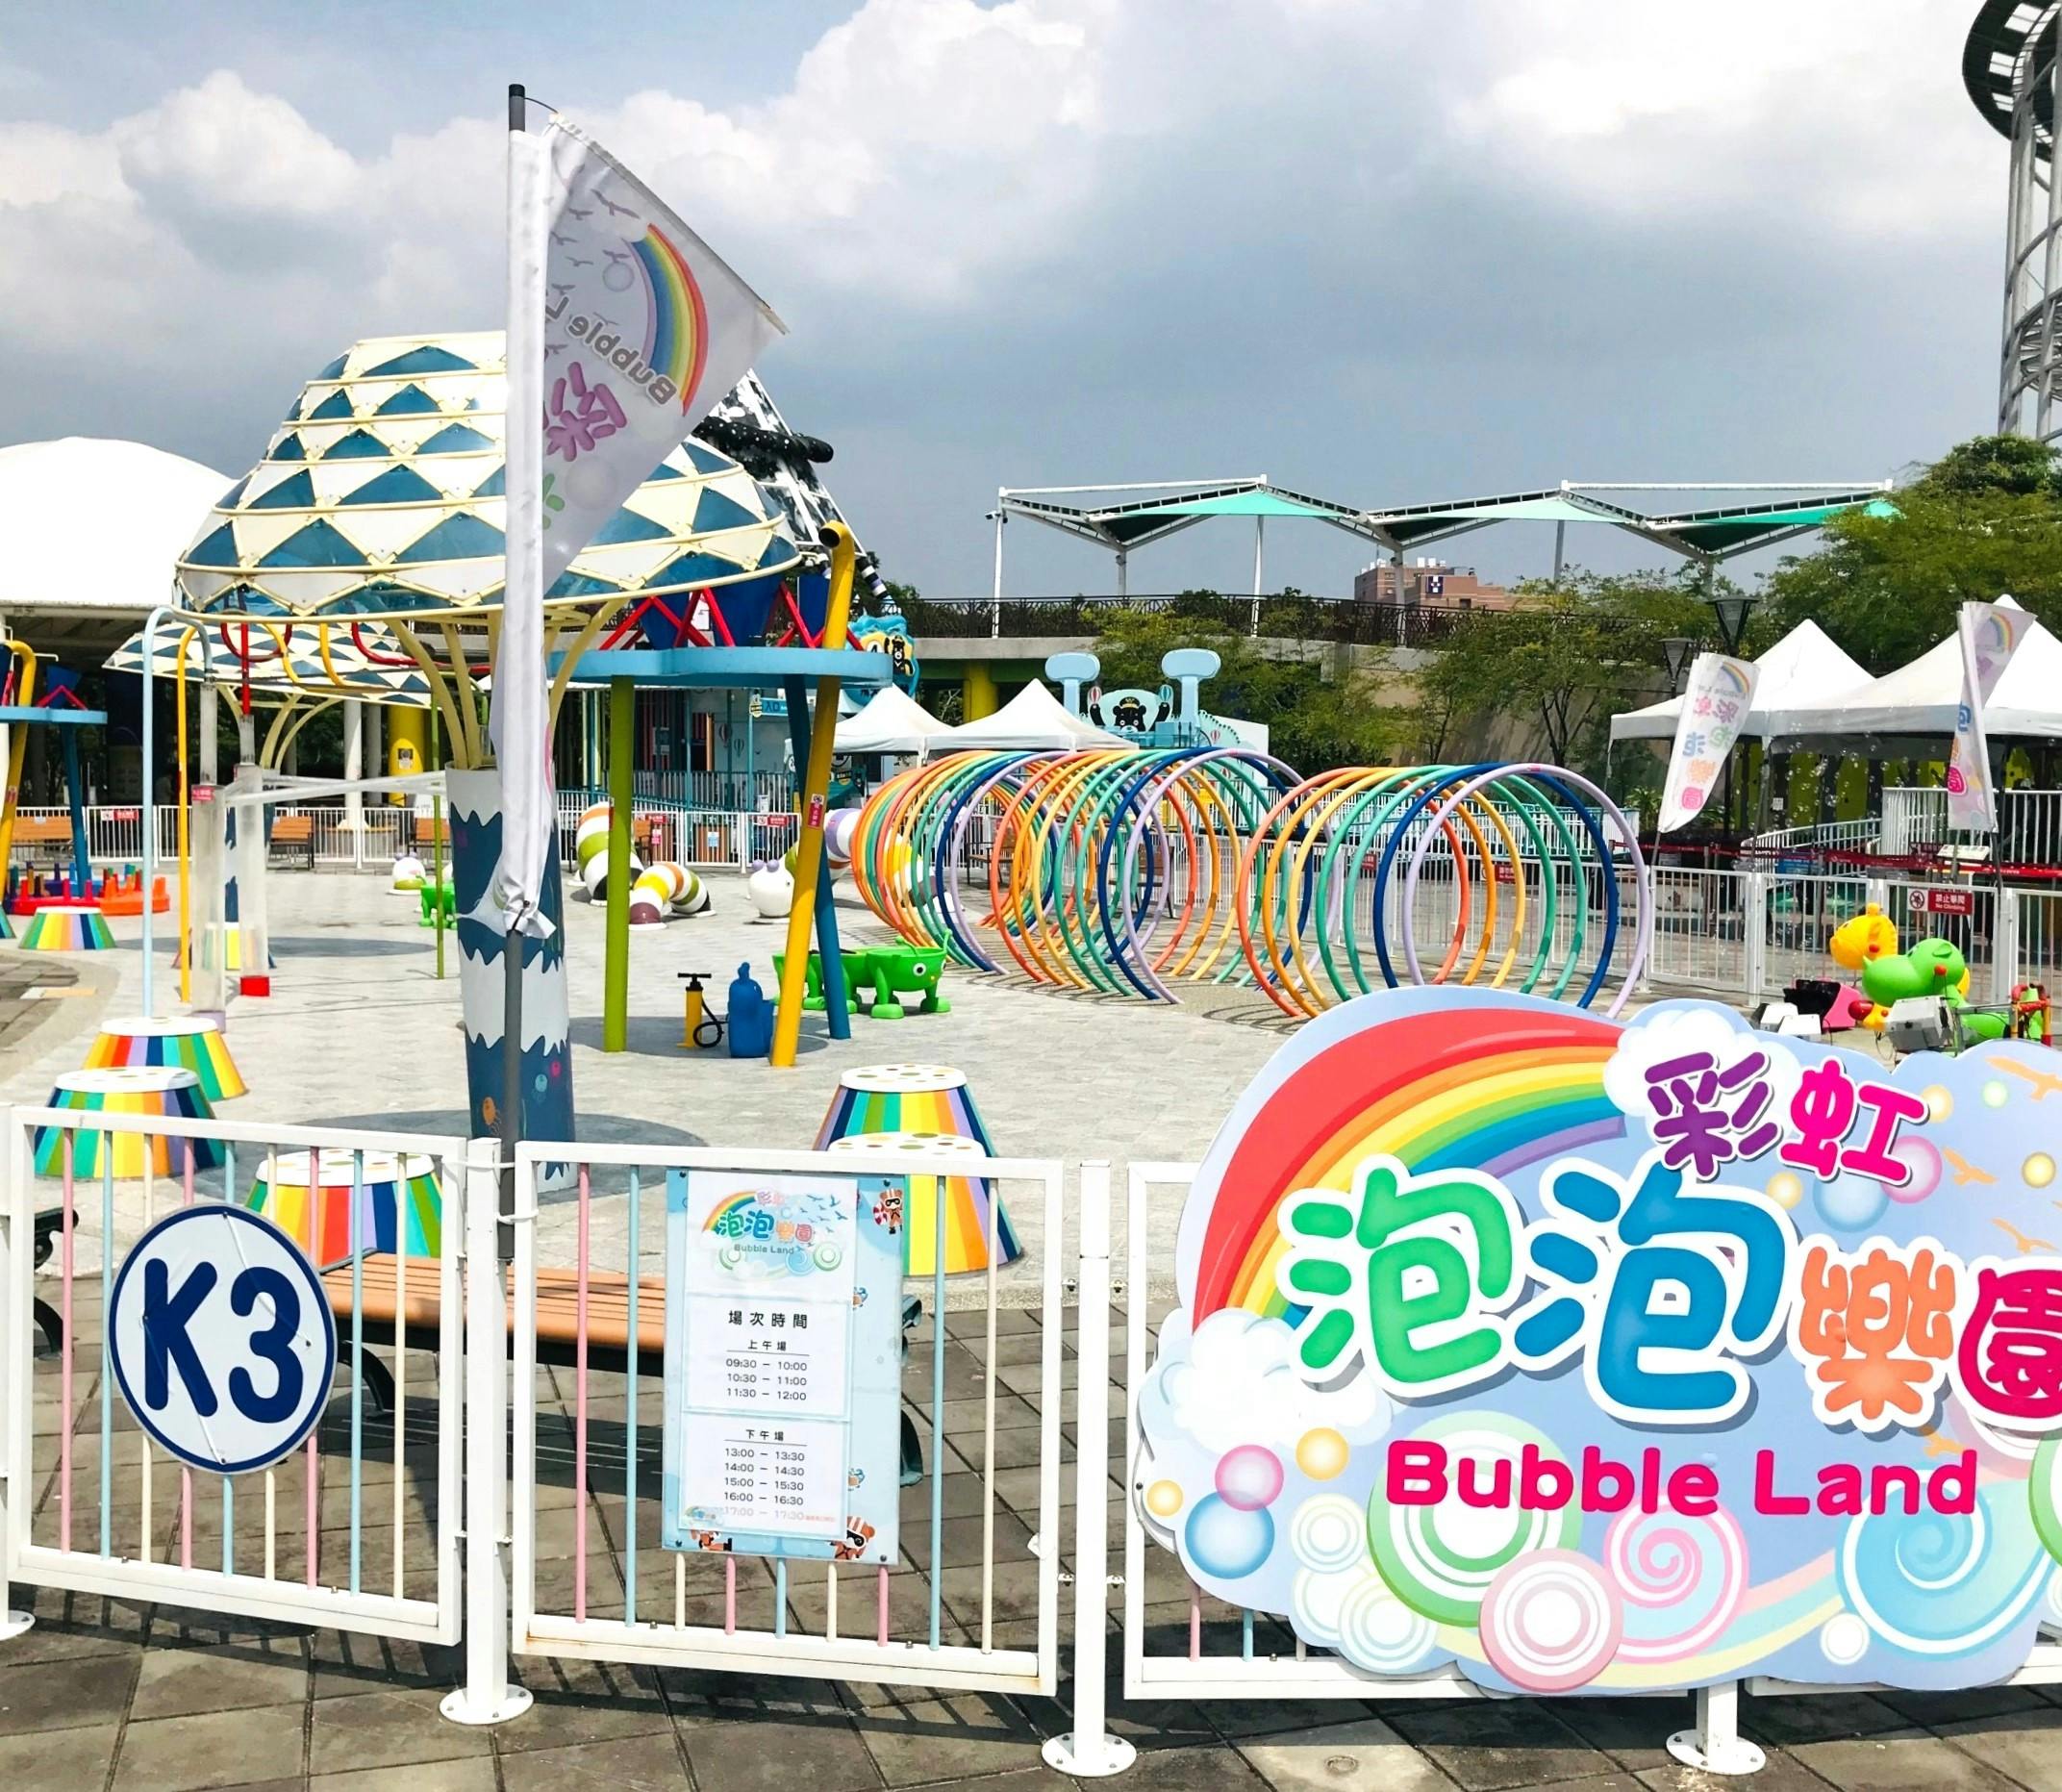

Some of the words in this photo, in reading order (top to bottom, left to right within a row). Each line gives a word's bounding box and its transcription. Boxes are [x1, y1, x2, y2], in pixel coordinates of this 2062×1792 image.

[1644, 1050, 1925, 1183] 彩虹
[734, 1244, 768, 1253] Bubble
[770, 1247, 795, 1255] Land
[728, 1310, 808, 1329] 場次時間
[144, 1258, 303, 1425] K3
[747, 1339, 787, 1351] 上午場
[725, 1358, 757, 1369] 09:30
[778, 1361, 808, 1372] 10:00
[727, 1373, 757, 1383] 10:30
[777, 1376, 808, 1386] 11:00
[727, 1388, 757, 1398] 11:30
[777, 1391, 807, 1401] 12:00
[745, 1429, 784, 1442] 下午場
[725, 1448, 755, 1458] 13:00
[775, 1451, 805, 1462] 13:30
[724, 1462, 755, 1473] 14:00
[775, 1466, 805, 1477] 14:30
[724, 1477, 754, 1487] 15:00
[774, 1480, 804, 1491] 15:30
[1386, 1440, 1720, 1516] Bubble
[1753, 1449, 1977, 1517] Land
[724, 1492, 753, 1502] 16:00
[774, 1496, 804, 1506] 16:30
